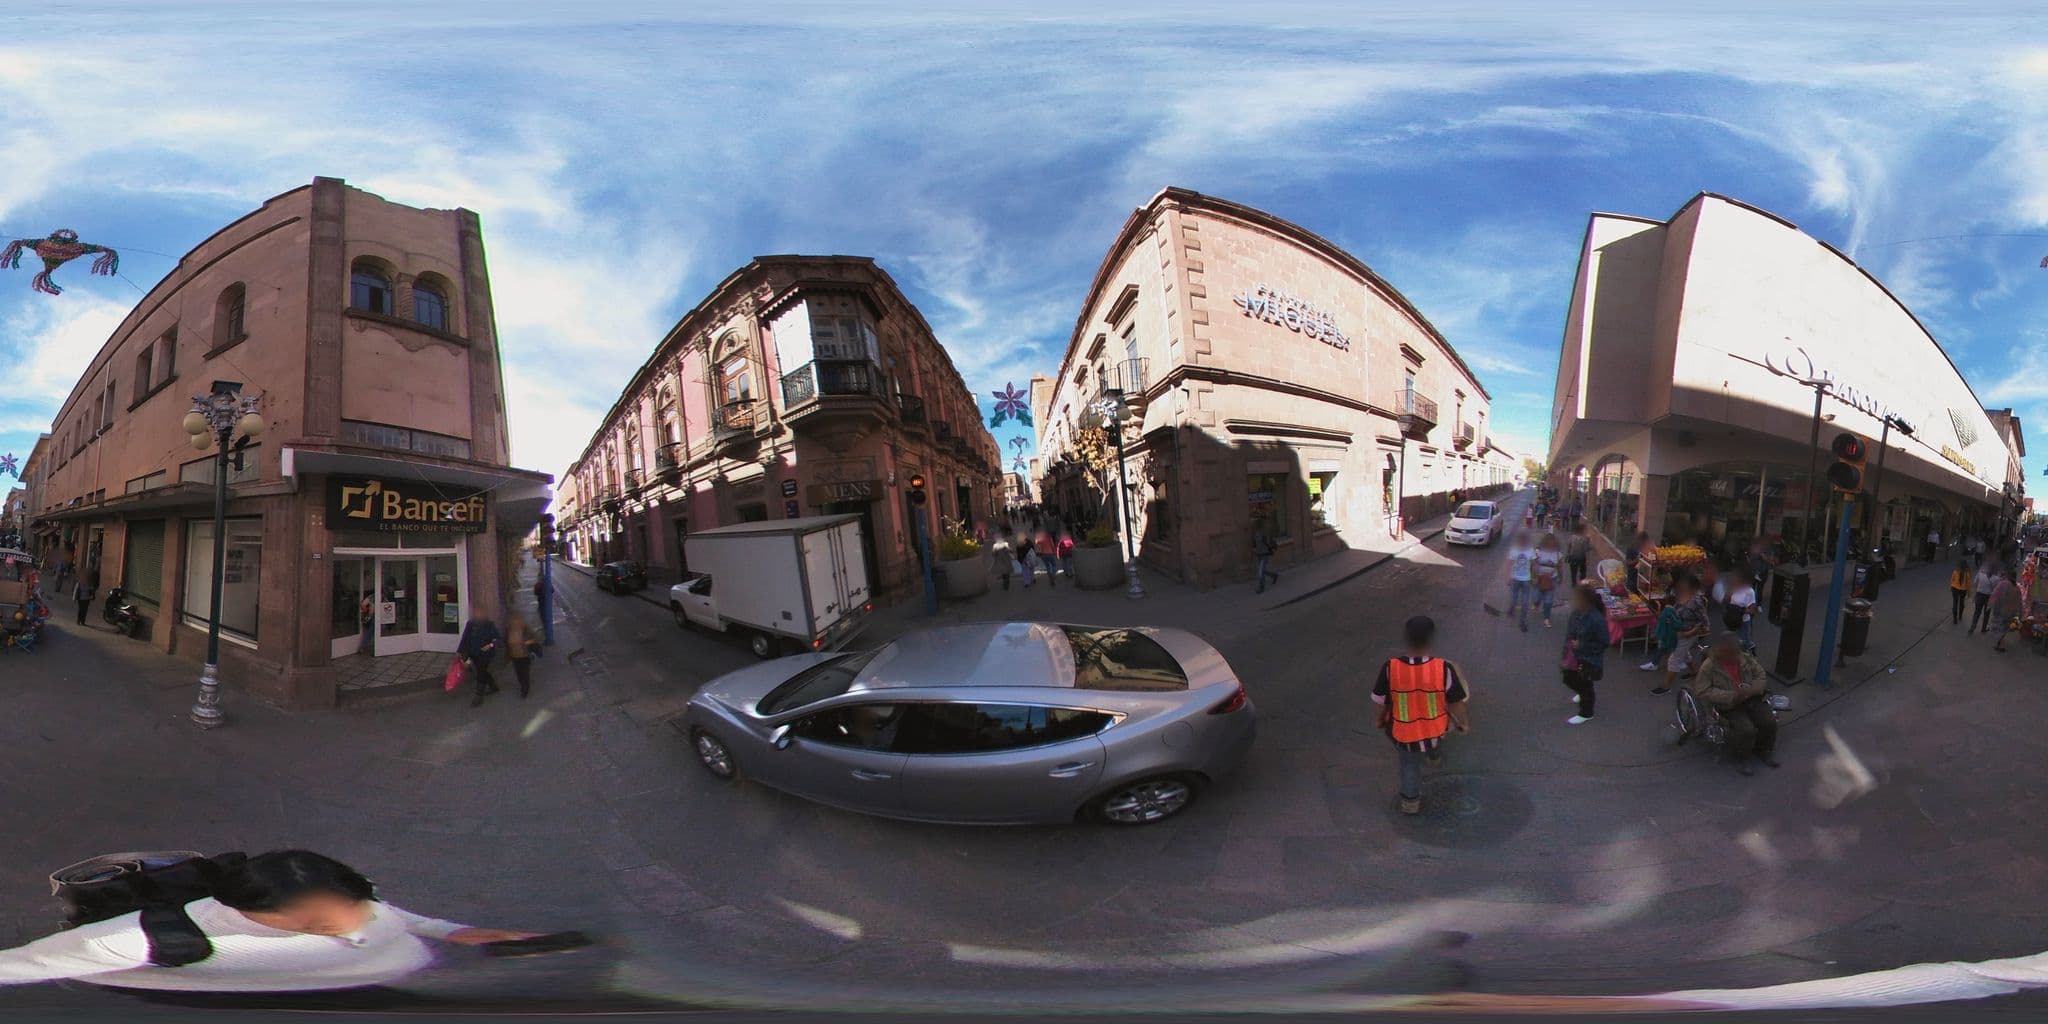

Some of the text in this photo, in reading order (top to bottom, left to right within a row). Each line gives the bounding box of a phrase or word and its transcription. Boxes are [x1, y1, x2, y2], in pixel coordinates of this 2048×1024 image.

[824, 481, 872, 497] MENS
[383, 489, 485, 522] Bansefi
[379, 522, 389, 530] EL
[392, 523, 420, 531] BANCO
[422, 524, 438, 532] QUE
